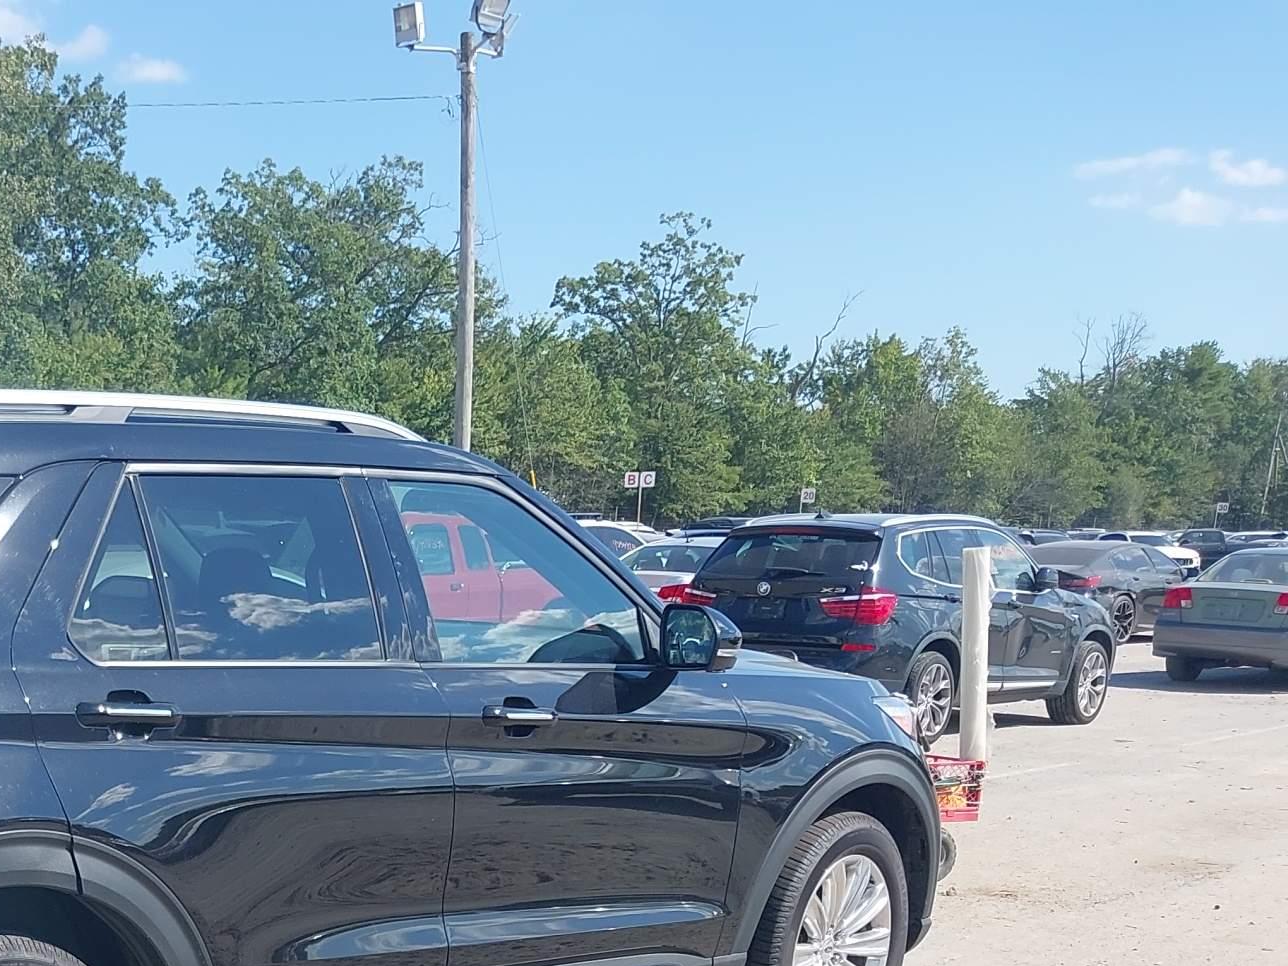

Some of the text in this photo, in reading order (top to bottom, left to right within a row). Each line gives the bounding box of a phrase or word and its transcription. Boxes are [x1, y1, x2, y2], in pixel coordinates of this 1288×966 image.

[627, 474, 637, 486] B
[643, 473, 653, 486] C
[802, 491, 815, 500] 20
